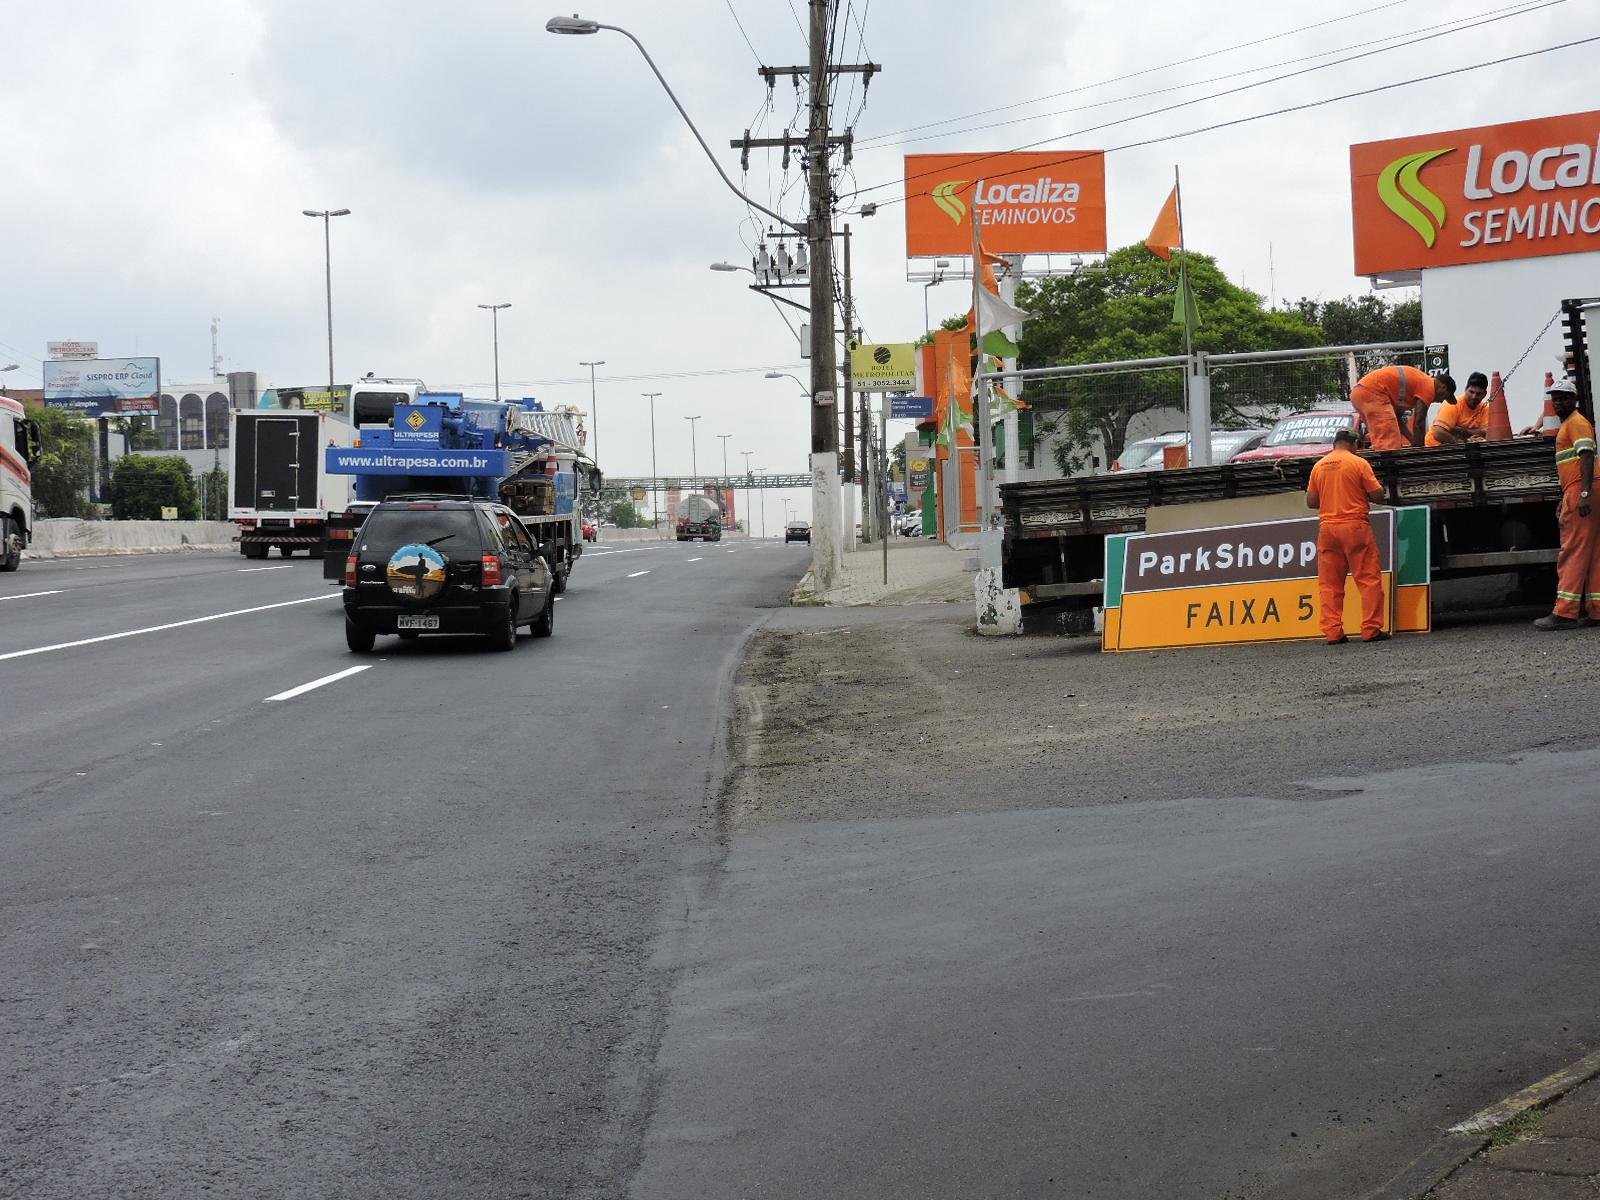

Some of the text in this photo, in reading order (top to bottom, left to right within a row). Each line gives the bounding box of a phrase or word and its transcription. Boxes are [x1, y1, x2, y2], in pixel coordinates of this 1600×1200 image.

[974, 178, 1080, 205] Localiza
[1460, 197, 1600, 247] SEMINO
[87, 373, 114, 381] SISPRO
[131, 372, 153, 380] Cloud
[1286, 416, 1350, 431] GARANTIA
[1273, 432, 1290, 444] DE
[338, 455, 488, 468] www.ultrapesa.com.br
[1186, 594, 1314, 629] FAIXA 5
